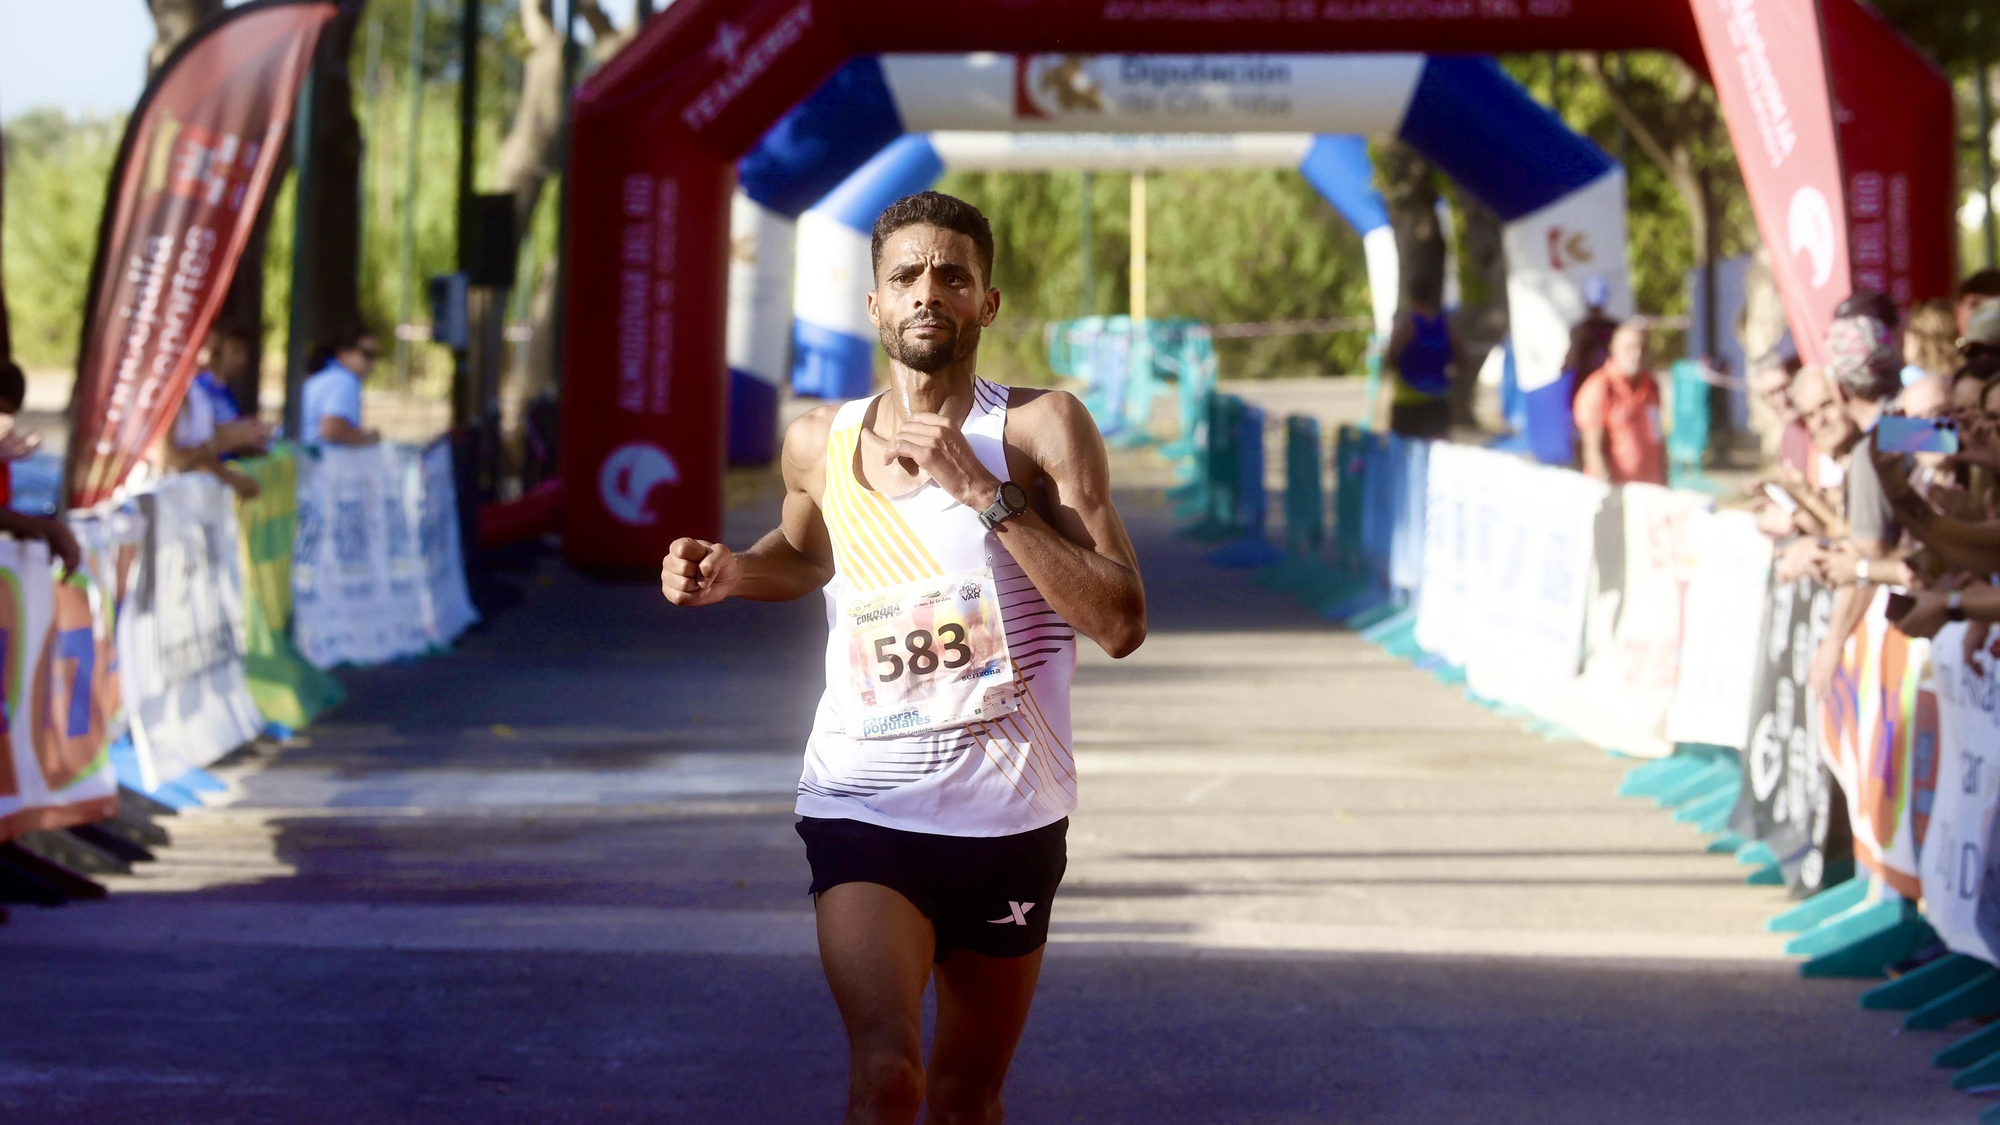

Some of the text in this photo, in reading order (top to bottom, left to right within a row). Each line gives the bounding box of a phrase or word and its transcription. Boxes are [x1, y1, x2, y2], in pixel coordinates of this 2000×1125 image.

[874, 623, 971, 682] 583
[863, 709, 919, 727] carreras
[863, 715, 931, 738] populares
